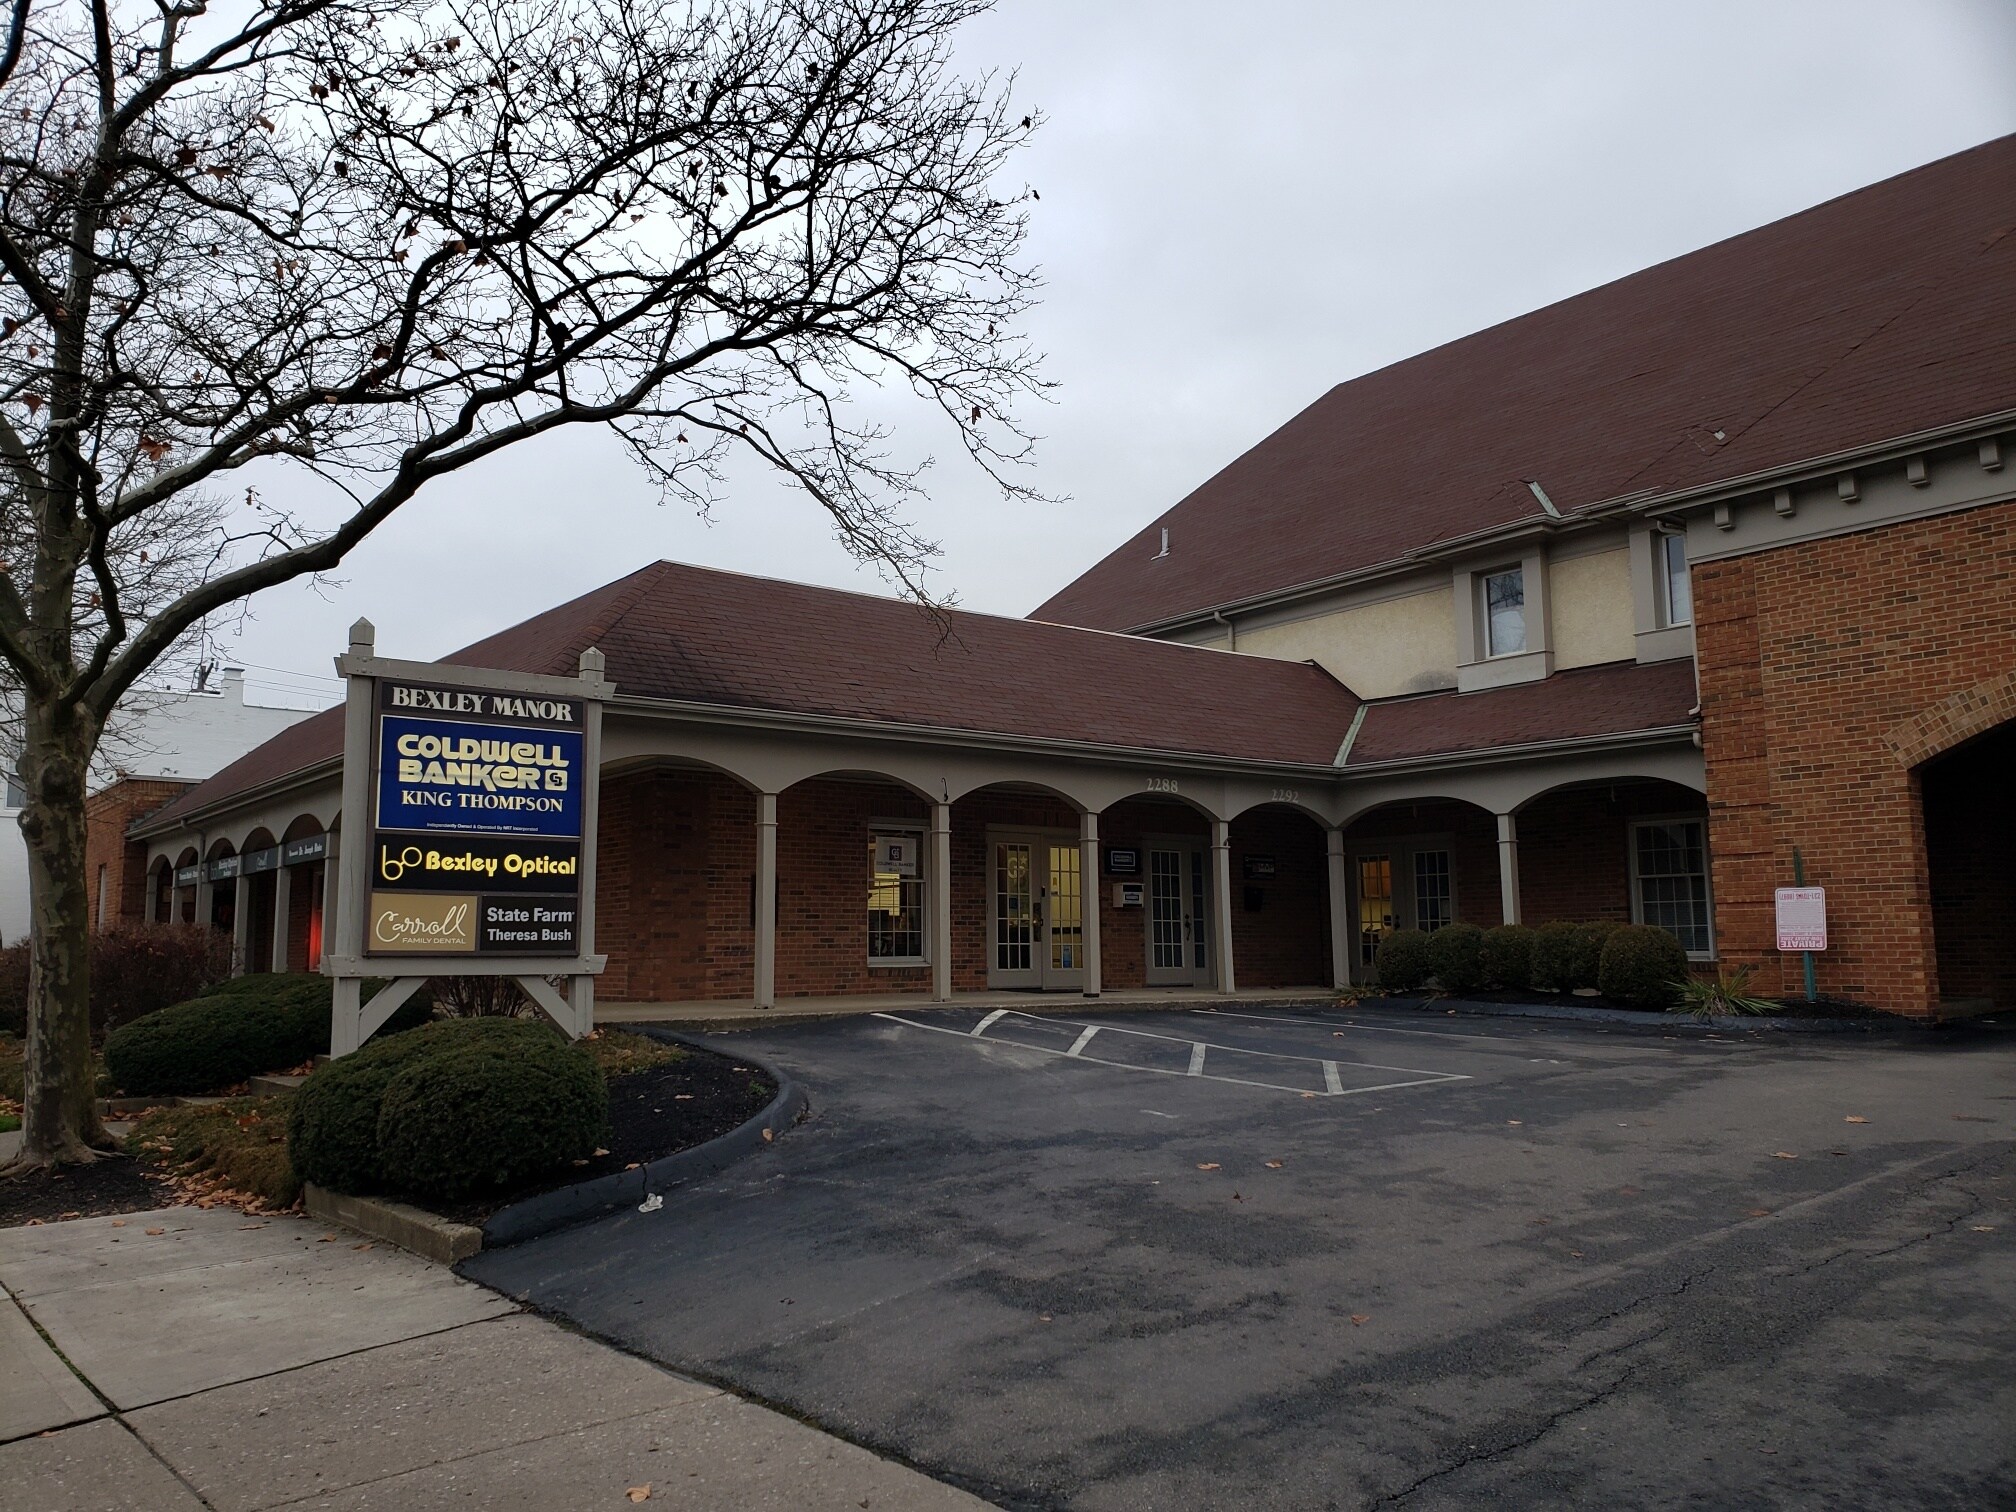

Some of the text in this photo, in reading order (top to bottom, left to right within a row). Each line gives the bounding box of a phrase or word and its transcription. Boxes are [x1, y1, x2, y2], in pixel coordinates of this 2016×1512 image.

[392, 687, 573, 722] BEXLEY MANOR
[397, 734, 570, 767] COLDWELL
[398, 758, 540, 792] BANKER
[401, 790, 564, 812] KING THOMPSON
[1146, 778, 1299, 804] 2288 2292
[425, 851, 576, 878] Bexley Optical
[375, 903, 468, 943] Carroll
[486, 907, 574, 923] State Farm
[487, 928, 572, 942] Theresa Bush
[1780, 940, 1823, 948] PRIVATE
